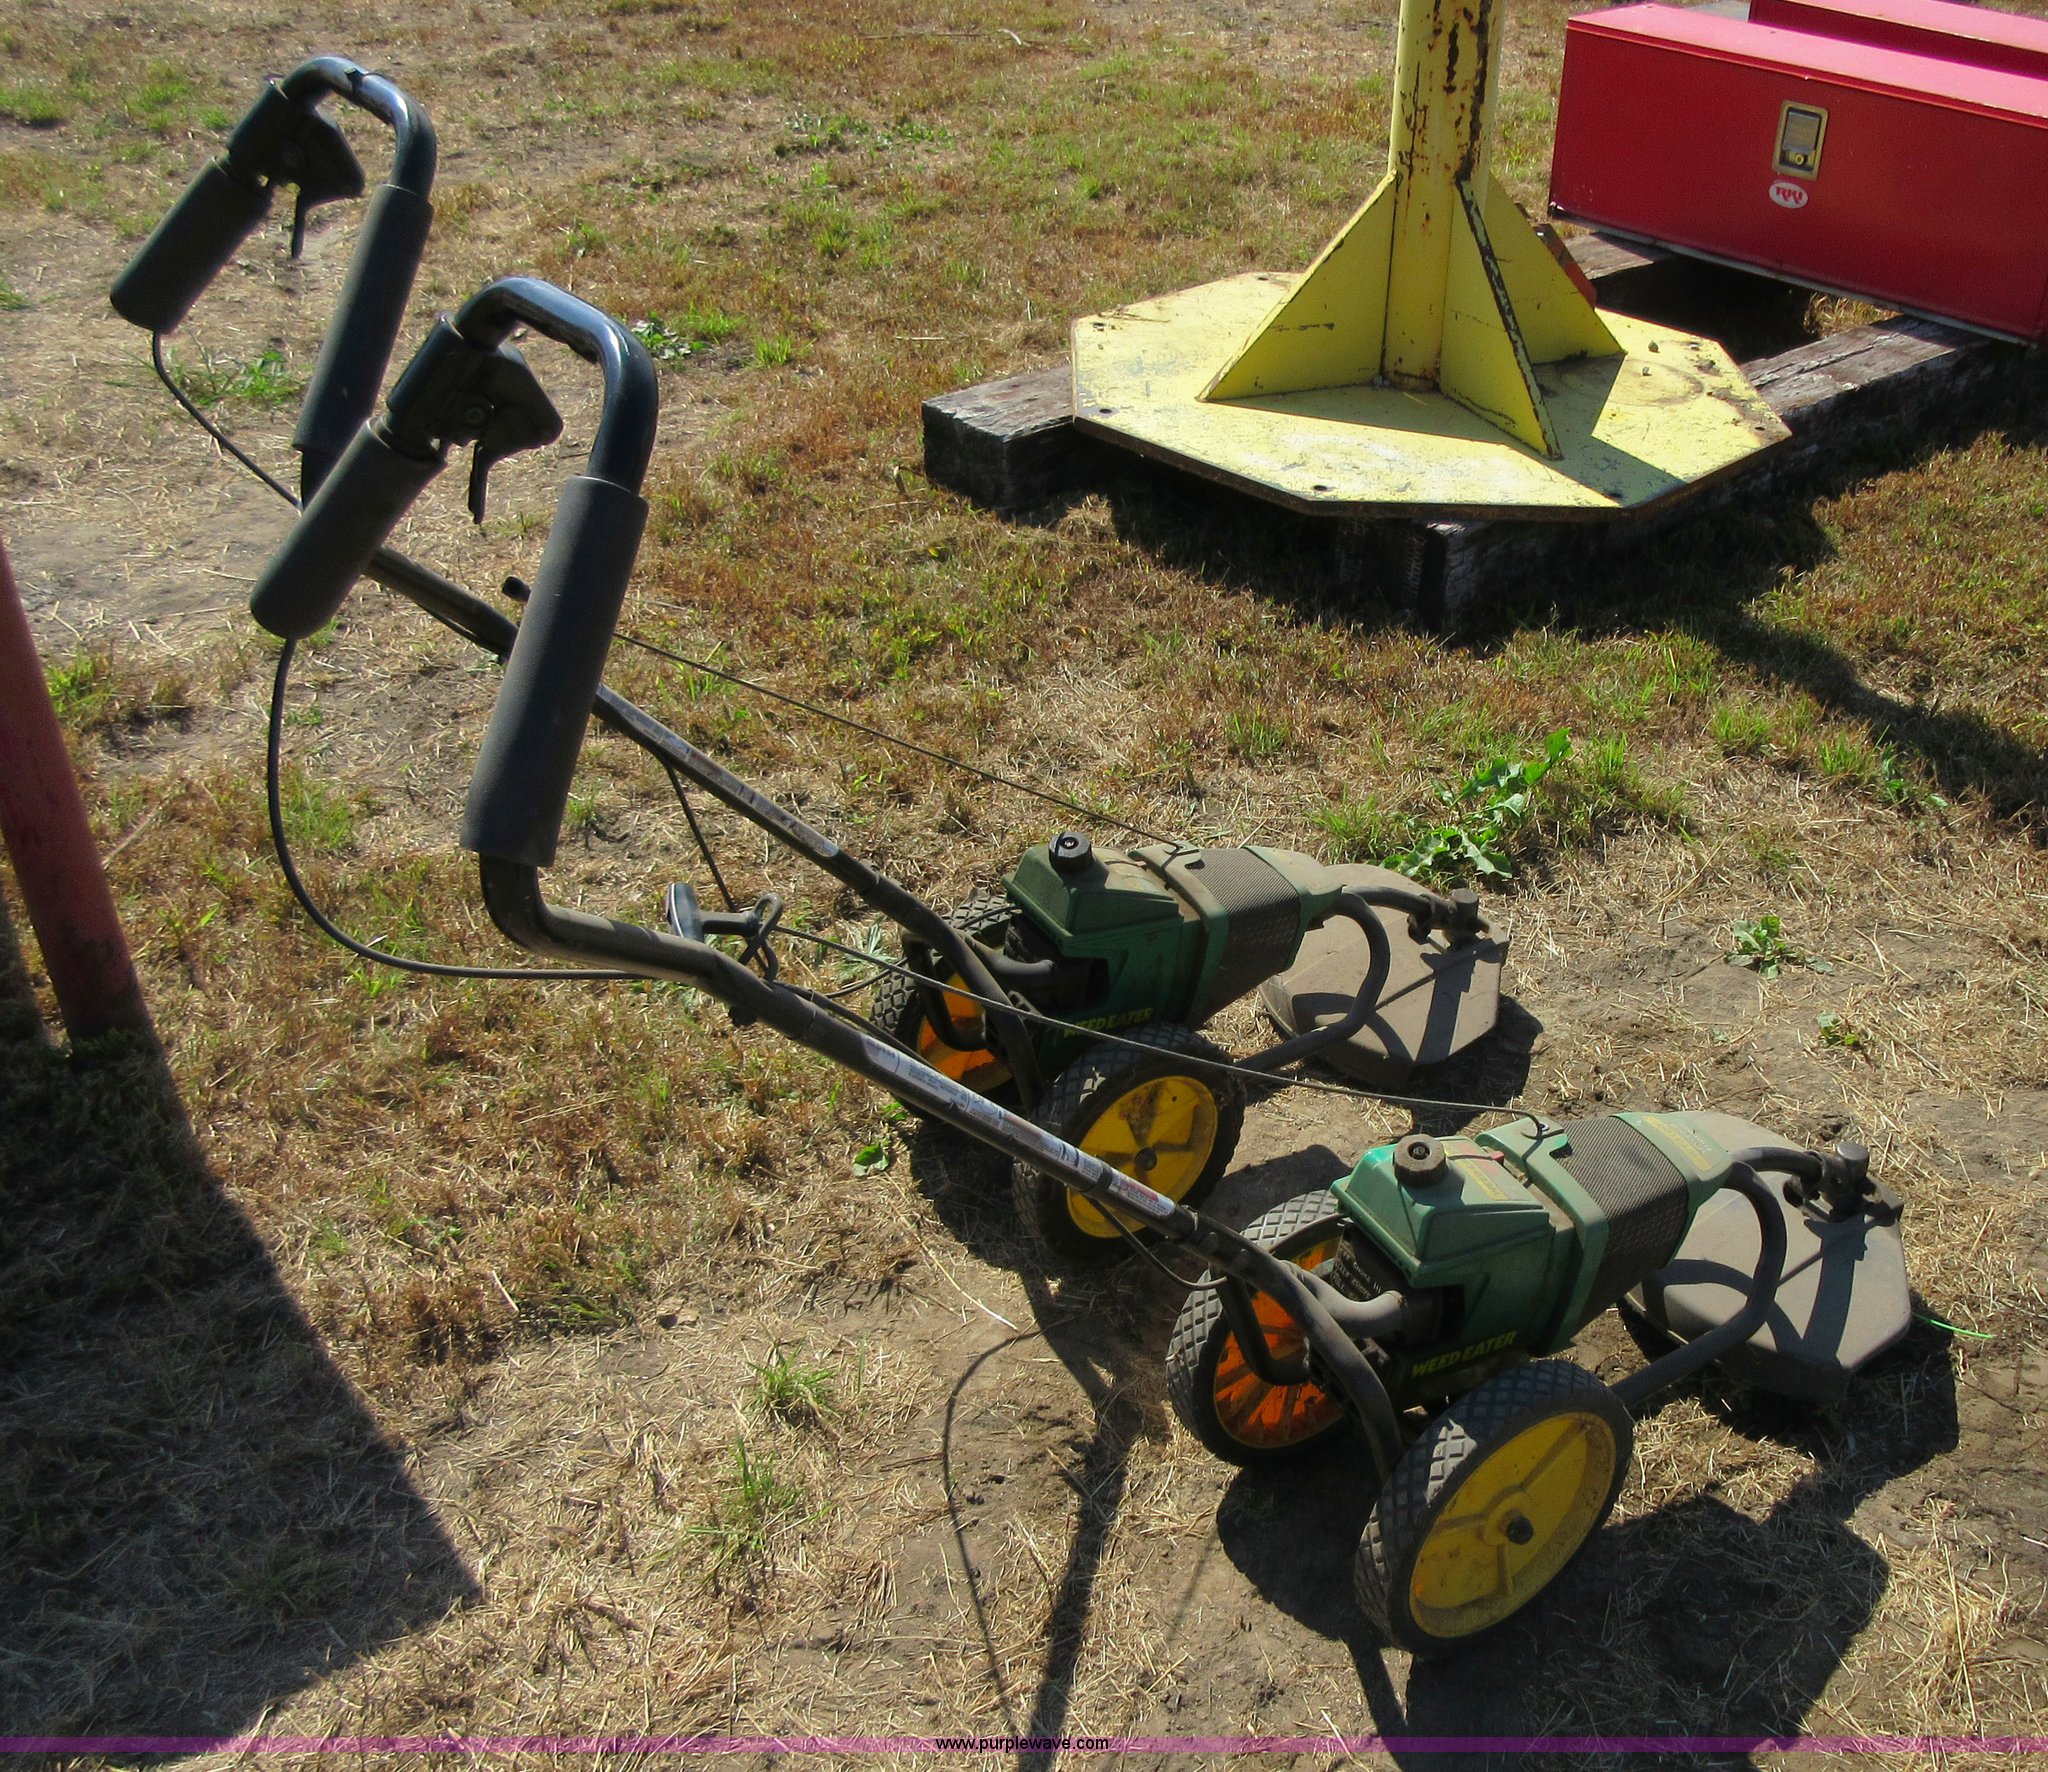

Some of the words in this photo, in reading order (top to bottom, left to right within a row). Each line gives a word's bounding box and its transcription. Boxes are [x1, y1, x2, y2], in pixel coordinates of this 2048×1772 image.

[1106, 1008, 1153, 1029] EATER
[1411, 1350, 1462, 1378] WEED
[1462, 1330, 1517, 1360] EATER
